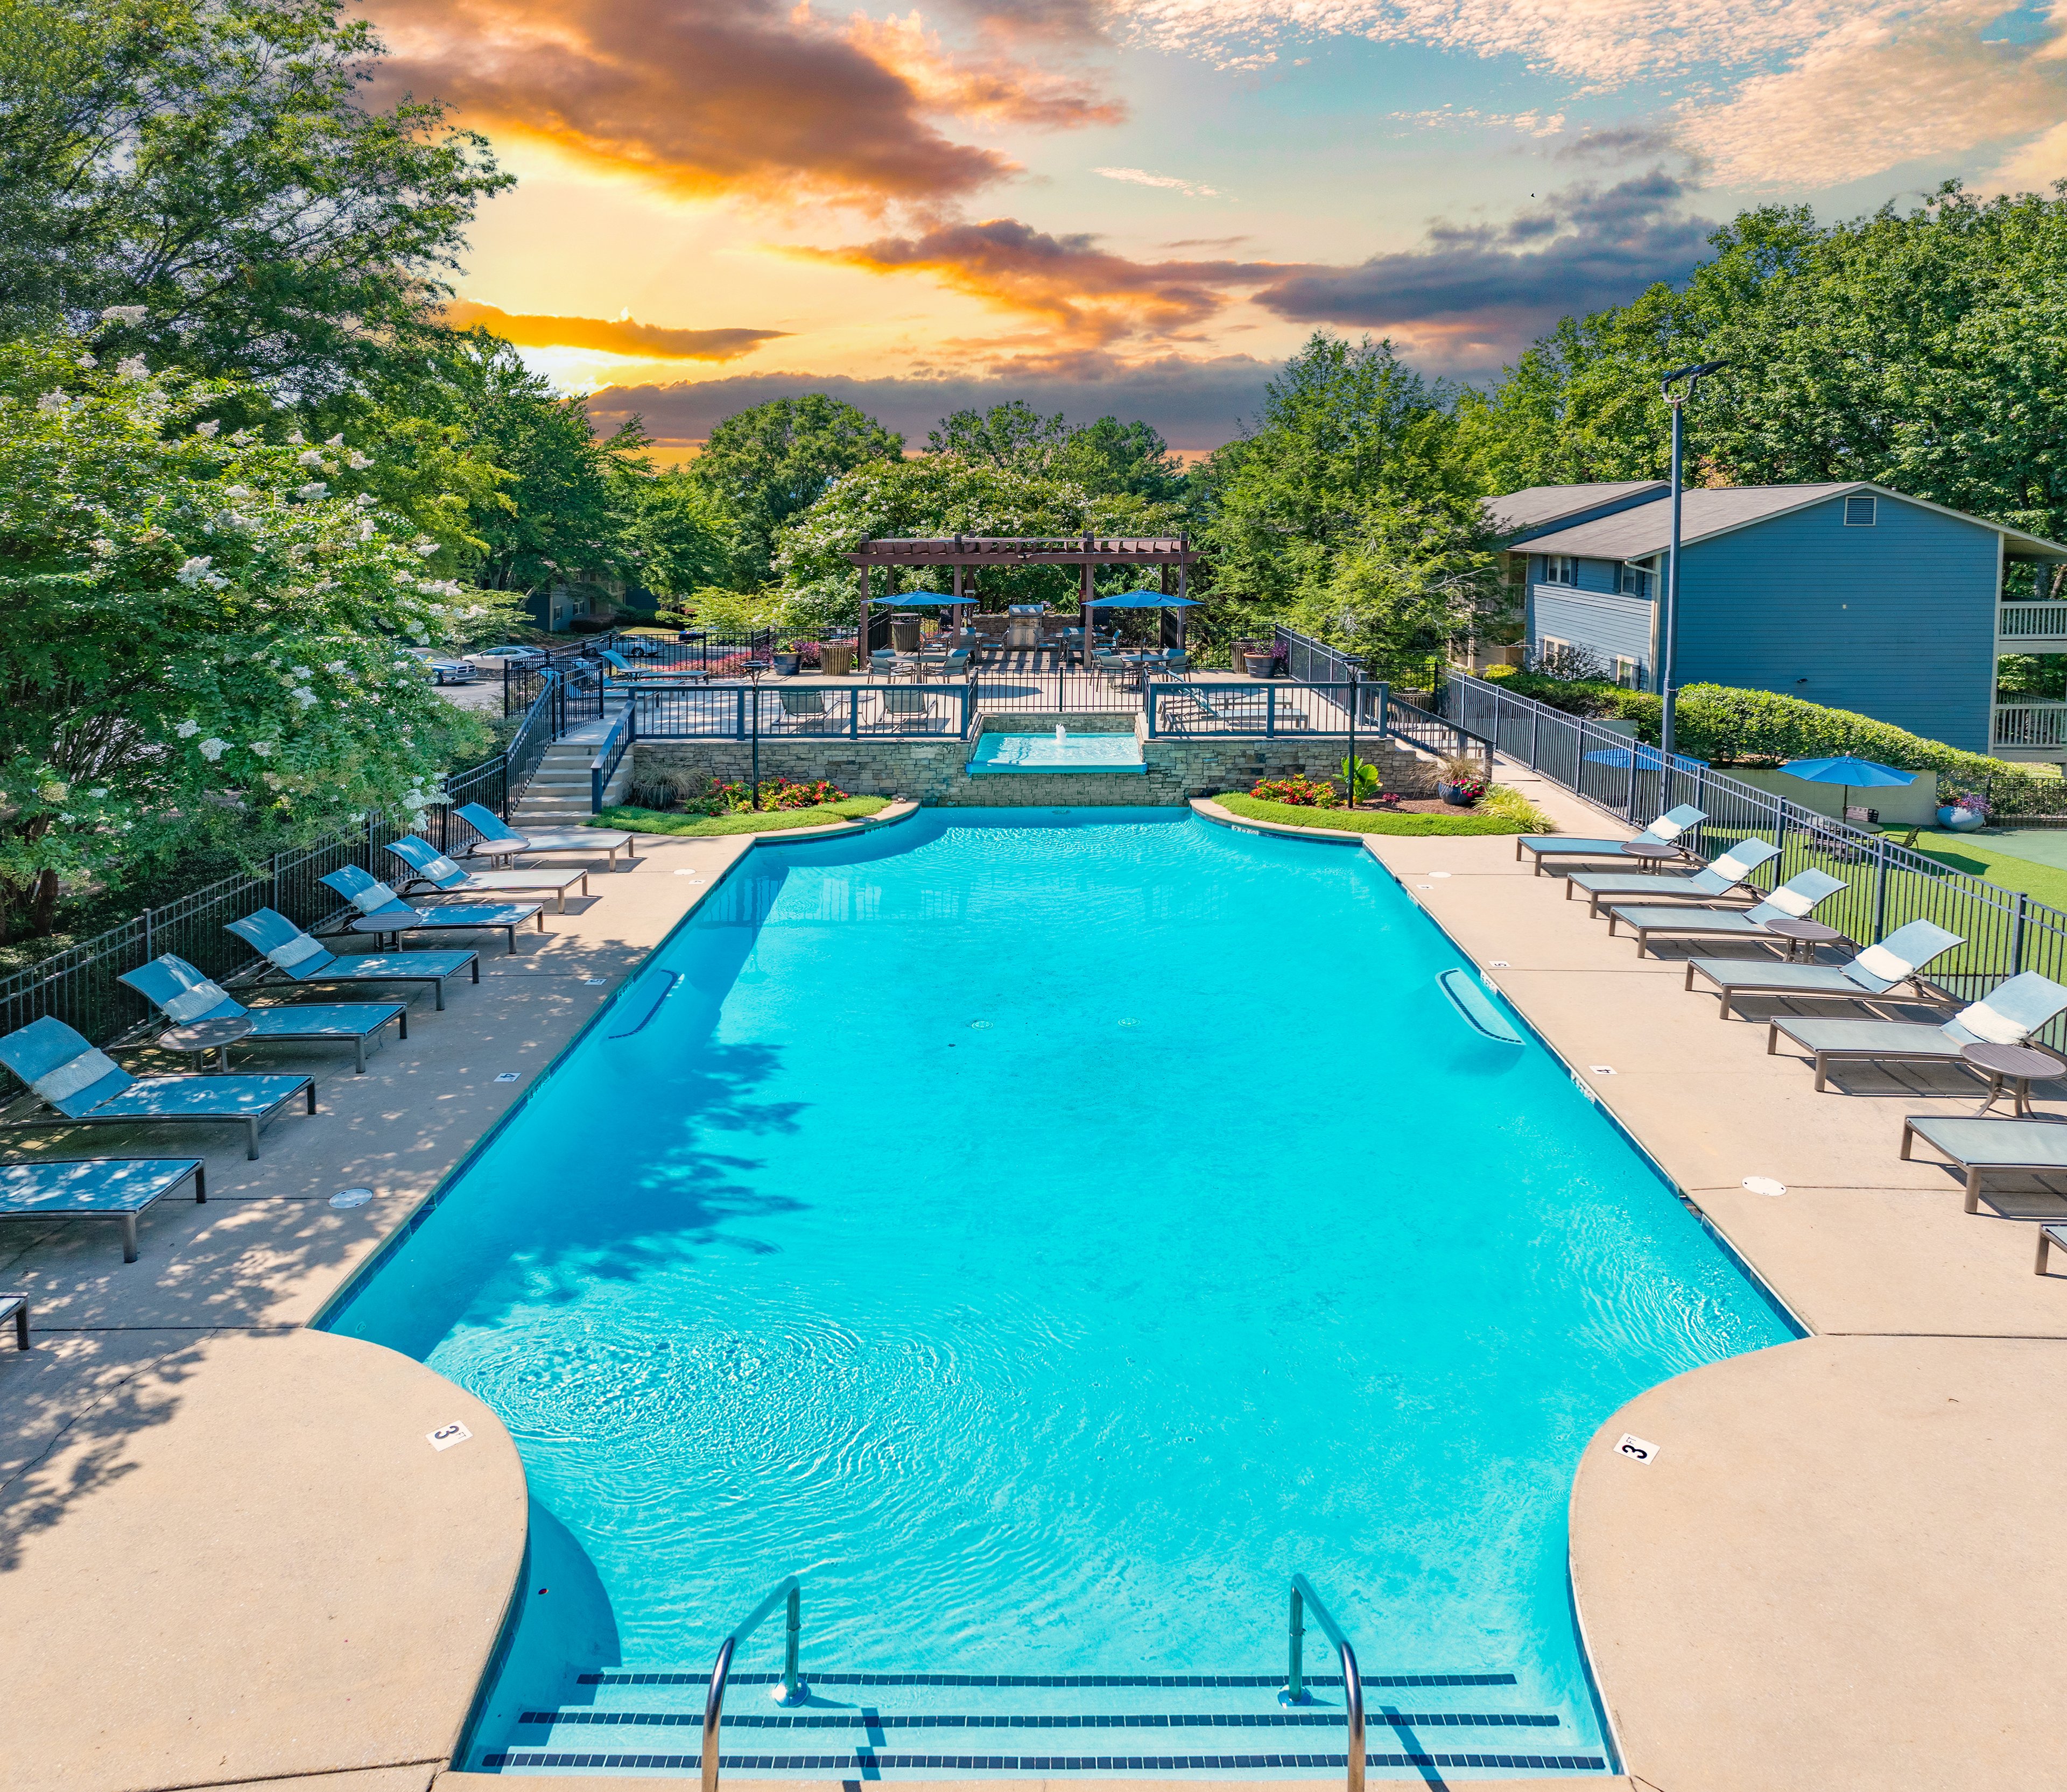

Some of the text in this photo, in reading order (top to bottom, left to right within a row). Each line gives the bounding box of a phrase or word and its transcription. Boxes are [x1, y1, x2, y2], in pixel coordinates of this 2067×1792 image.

[434, 1426, 459, 1440] 3
[1626, 1436, 1636, 1445] FT
[1622, 1444, 1648, 1459] 3
